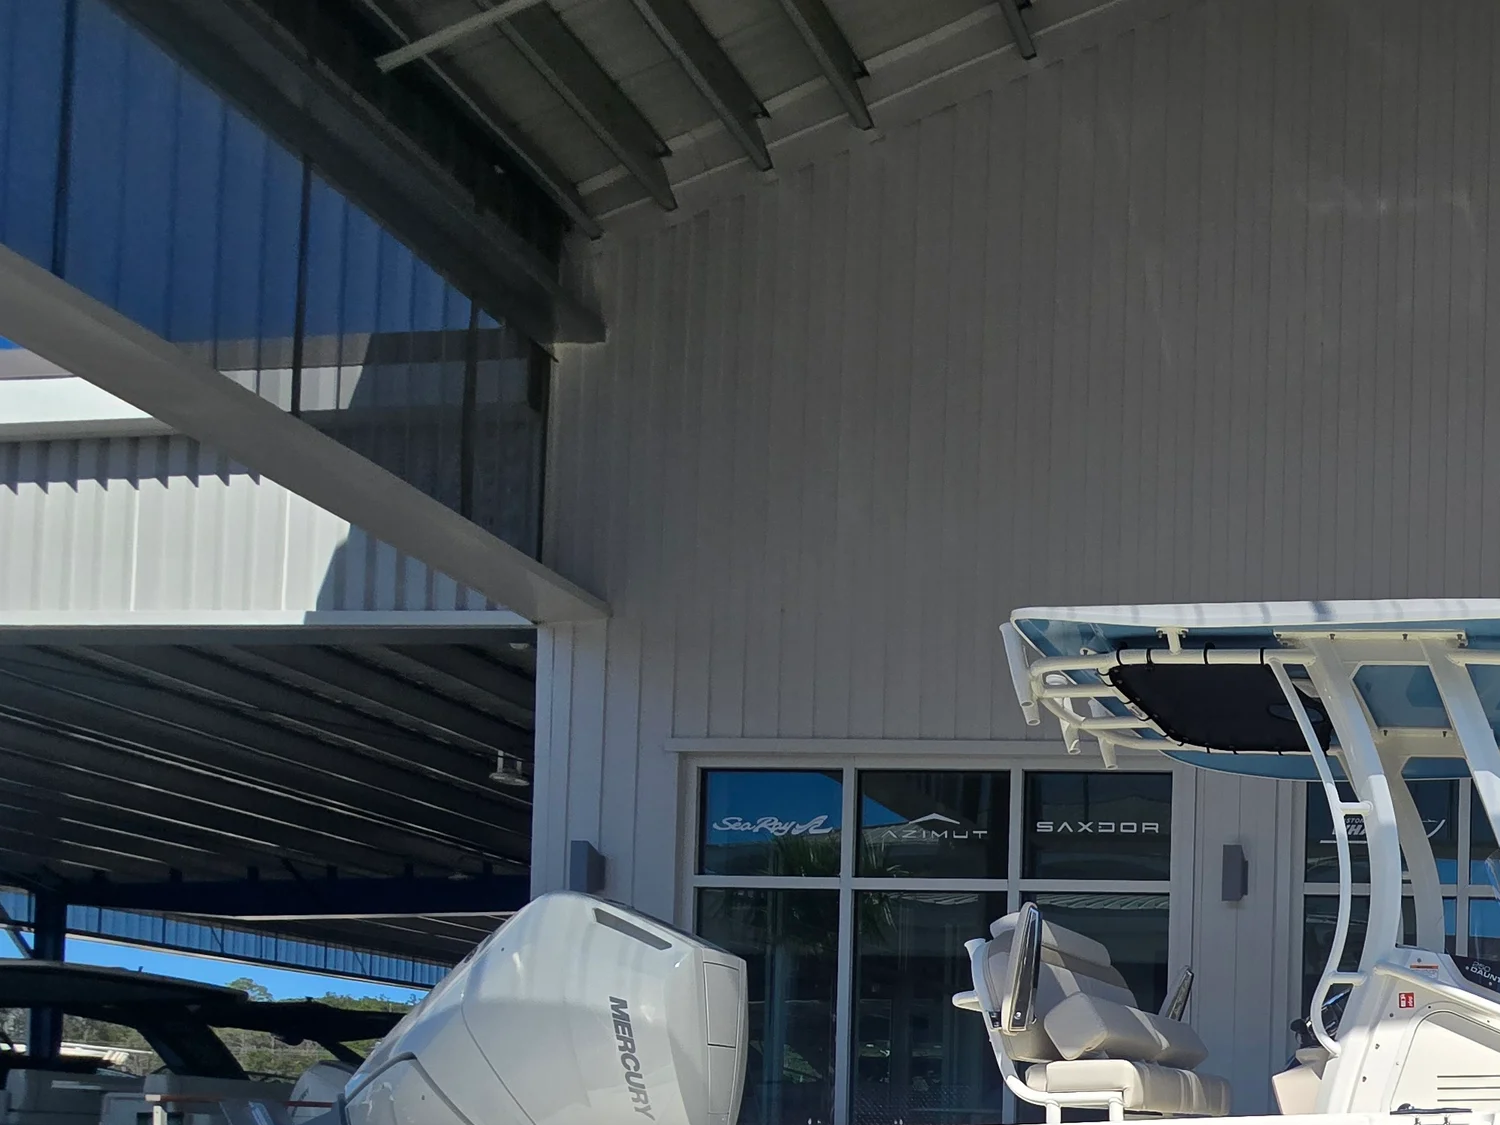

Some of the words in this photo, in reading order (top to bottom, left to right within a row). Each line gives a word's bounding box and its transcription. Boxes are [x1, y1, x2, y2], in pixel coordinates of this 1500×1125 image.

[713, 816, 755, 831] Sea
[753, 816, 796, 836] Ray
[881, 829, 988, 839] AZIMUT
[1036, 821, 1159, 833] SAXDOR
[609, 996, 656, 1121] MERCURY
